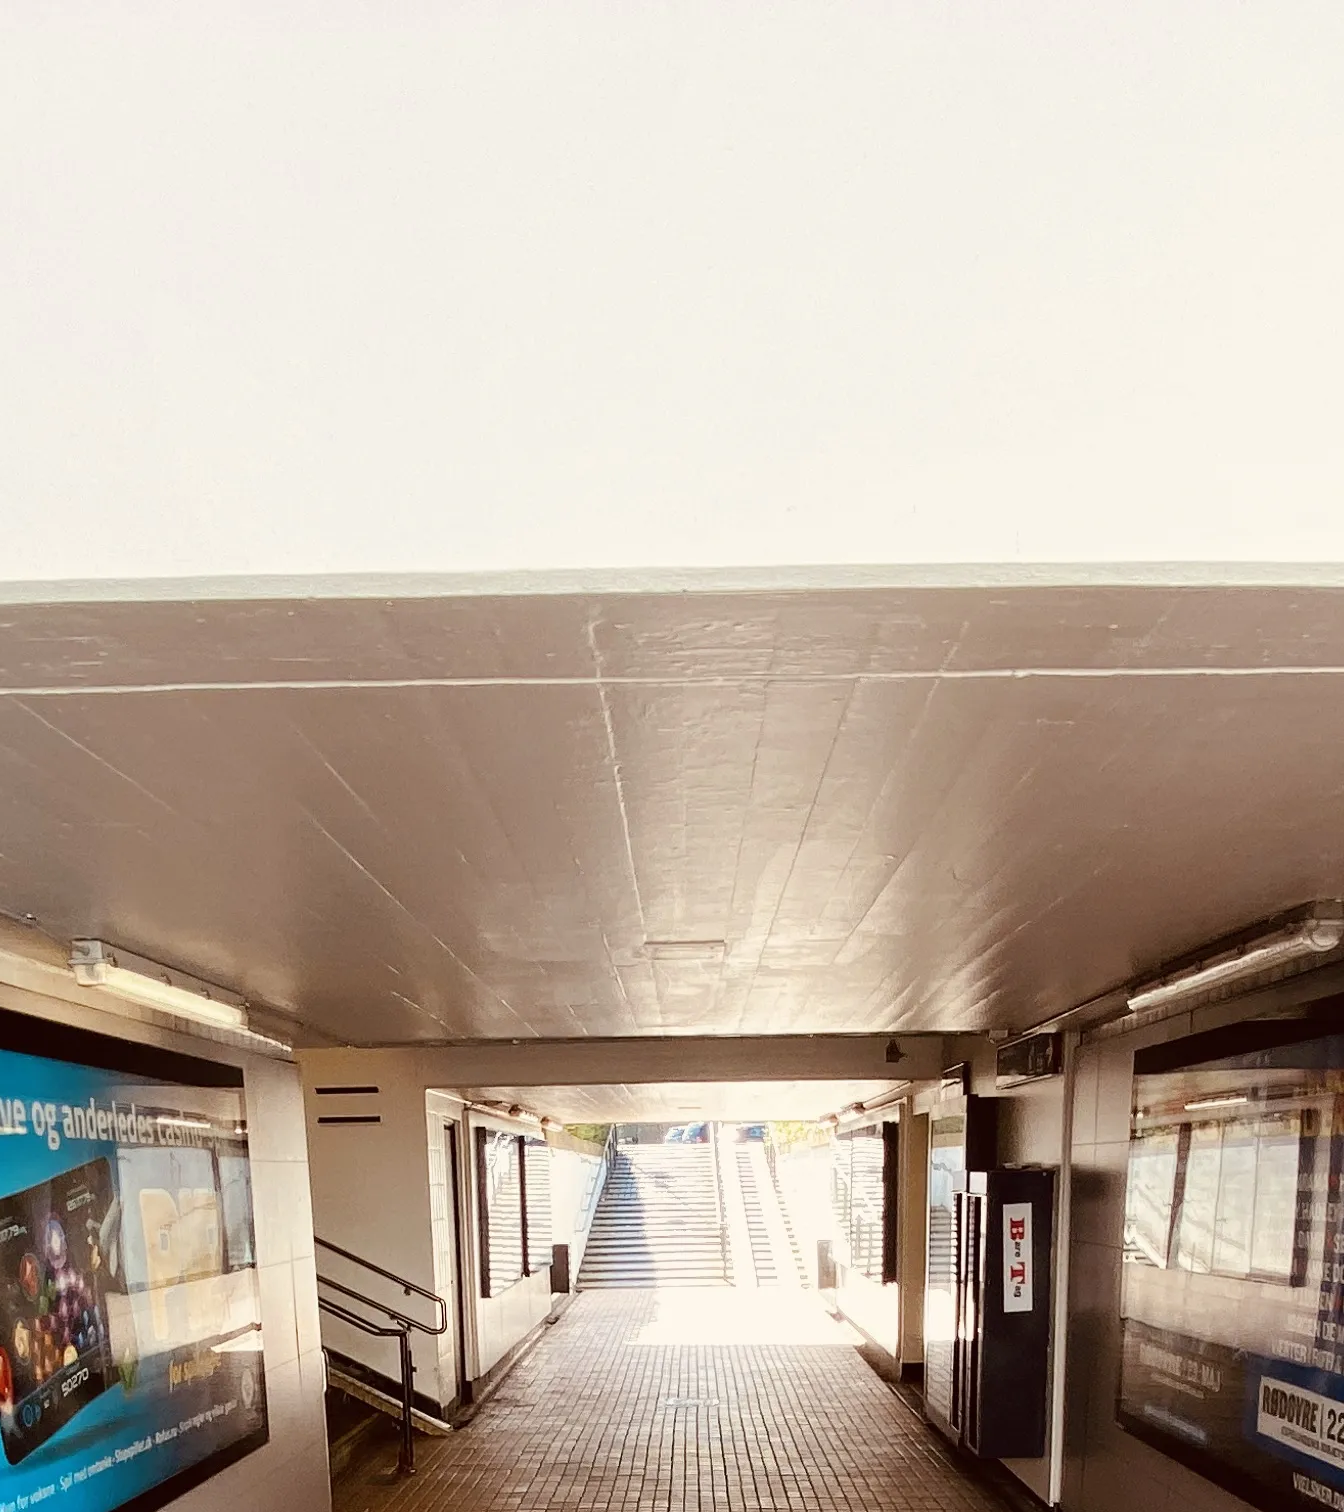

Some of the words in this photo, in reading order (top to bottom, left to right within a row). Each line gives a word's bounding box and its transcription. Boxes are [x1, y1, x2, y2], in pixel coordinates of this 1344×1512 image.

[31, 1101, 61, 1150] og
[62, 1098, 153, 1144] anderledes
[1010, 1217, 1025, 1257] Bare
[1010, 1261, 1025, 1297] Tag
